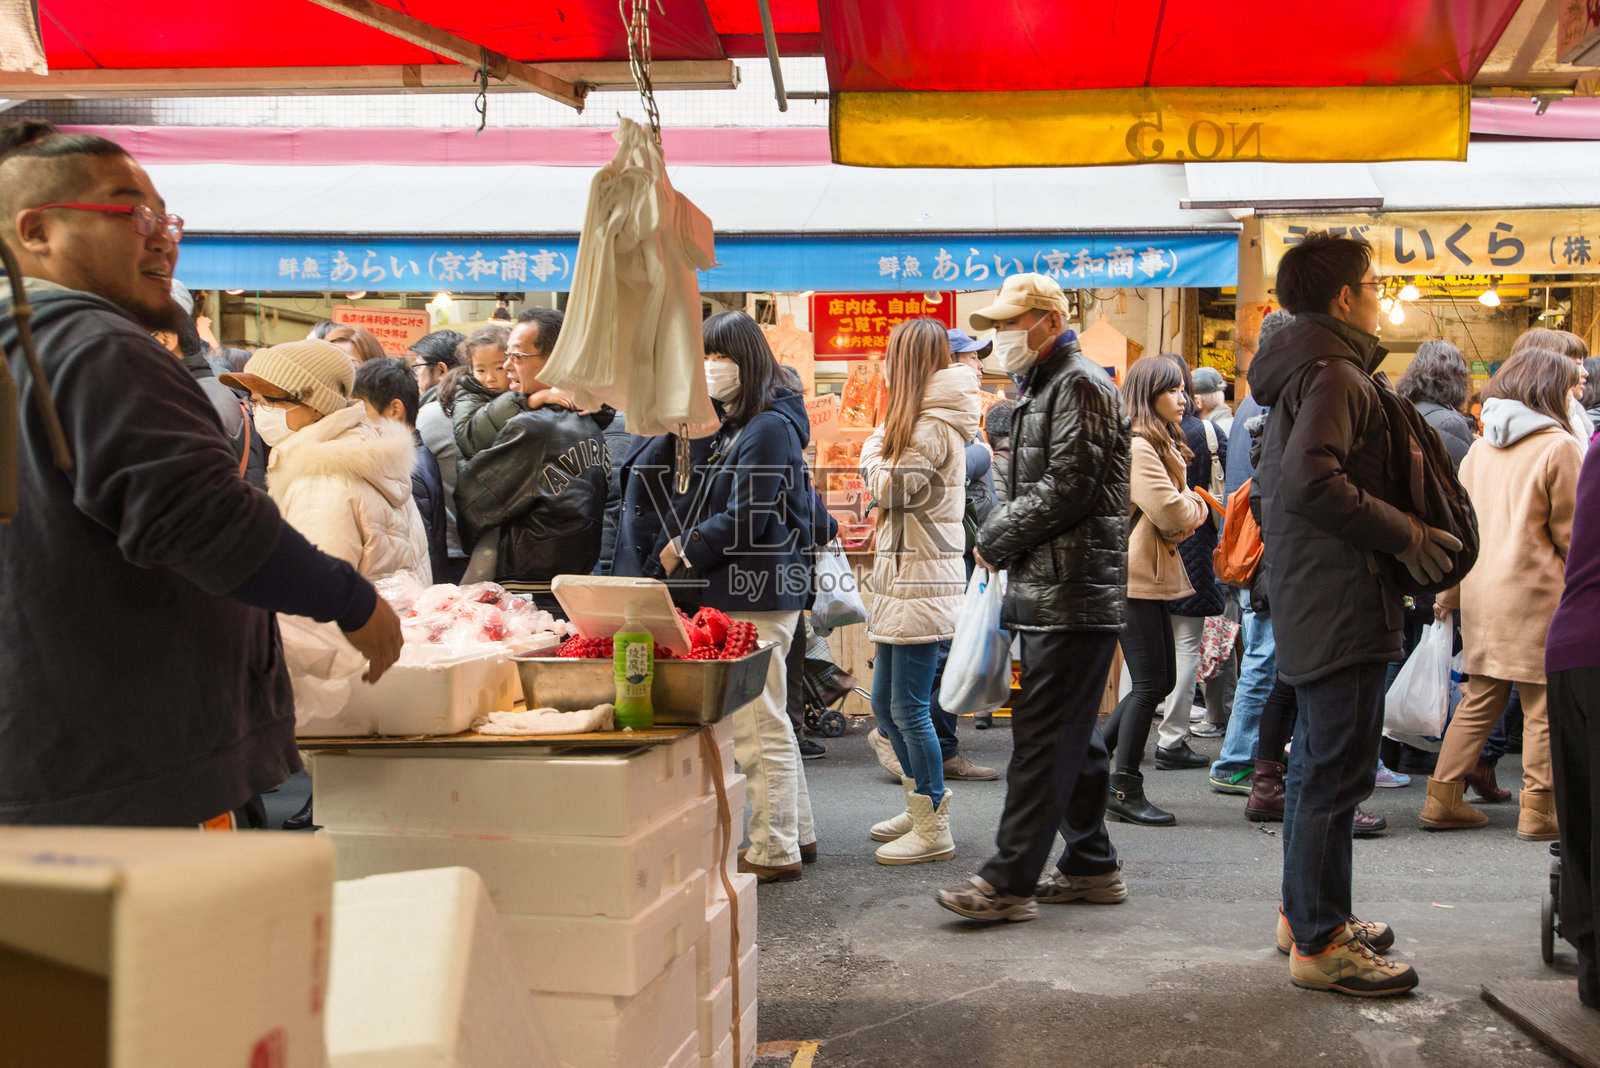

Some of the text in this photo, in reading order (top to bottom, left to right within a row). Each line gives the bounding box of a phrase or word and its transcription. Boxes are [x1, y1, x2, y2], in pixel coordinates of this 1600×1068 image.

[838, 316, 911, 333] ご覧下さ
[542, 438, 613, 496] AVIRE
